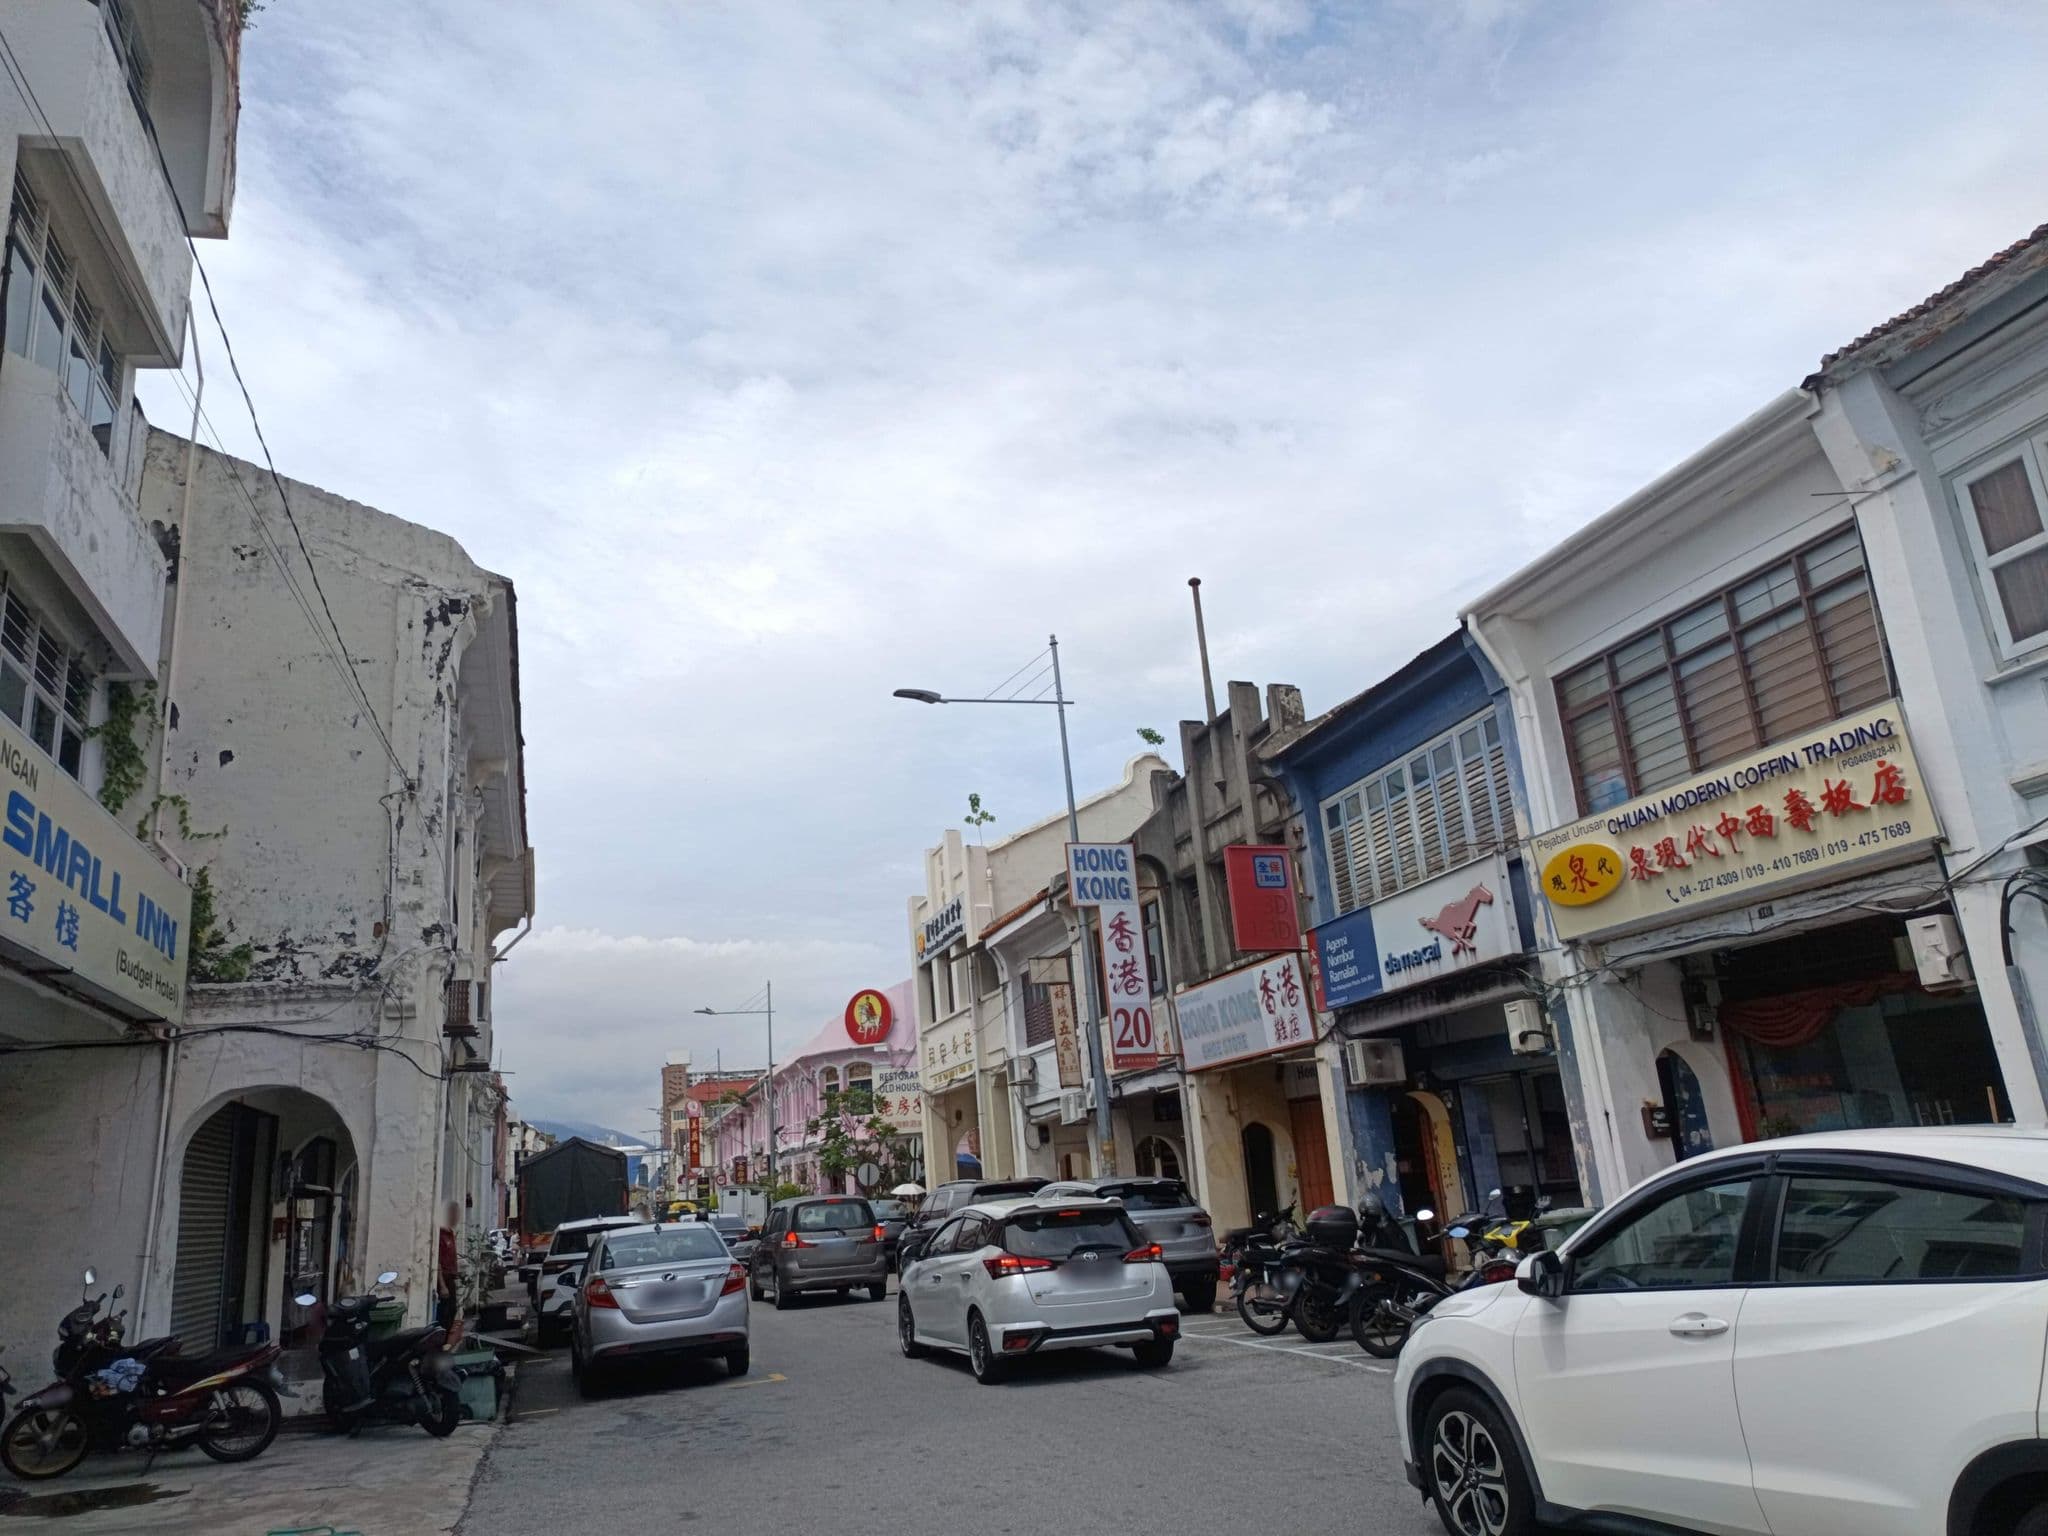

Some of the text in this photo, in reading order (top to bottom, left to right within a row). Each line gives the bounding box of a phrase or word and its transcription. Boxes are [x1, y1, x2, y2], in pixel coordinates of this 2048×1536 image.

[1607, 719, 1893, 835] CHUAN MODERN COFFIN TRADING
[1074, 848, 1128, 872] HONG
[1537, 819, 1607, 851] Pejabat Urusan
[1679, 884, 1692, 898] 04
[1699, 878, 1715, 892] 227
[1716, 871, 1739, 888] 4309
[1746, 866, 1765, 879] 019
[1772, 856, 1791, 871] 410
[1795, 848, 1819, 866] 7689
[1827, 840, 1849, 856] 019
[1858, 830, 1880, 847] 475
[1884, 820, 1912, 840] 7689
[3, 790, 178, 961] SMALL INN
[1077, 877, 1131, 900] KONG
[116, 949, 180, 1006] (Budget Hotel)
[1107, 911, 1144, 996] 香港
[1260, 958, 1300, 1015] 香港
[1114, 1007, 1151, 1048] 20
